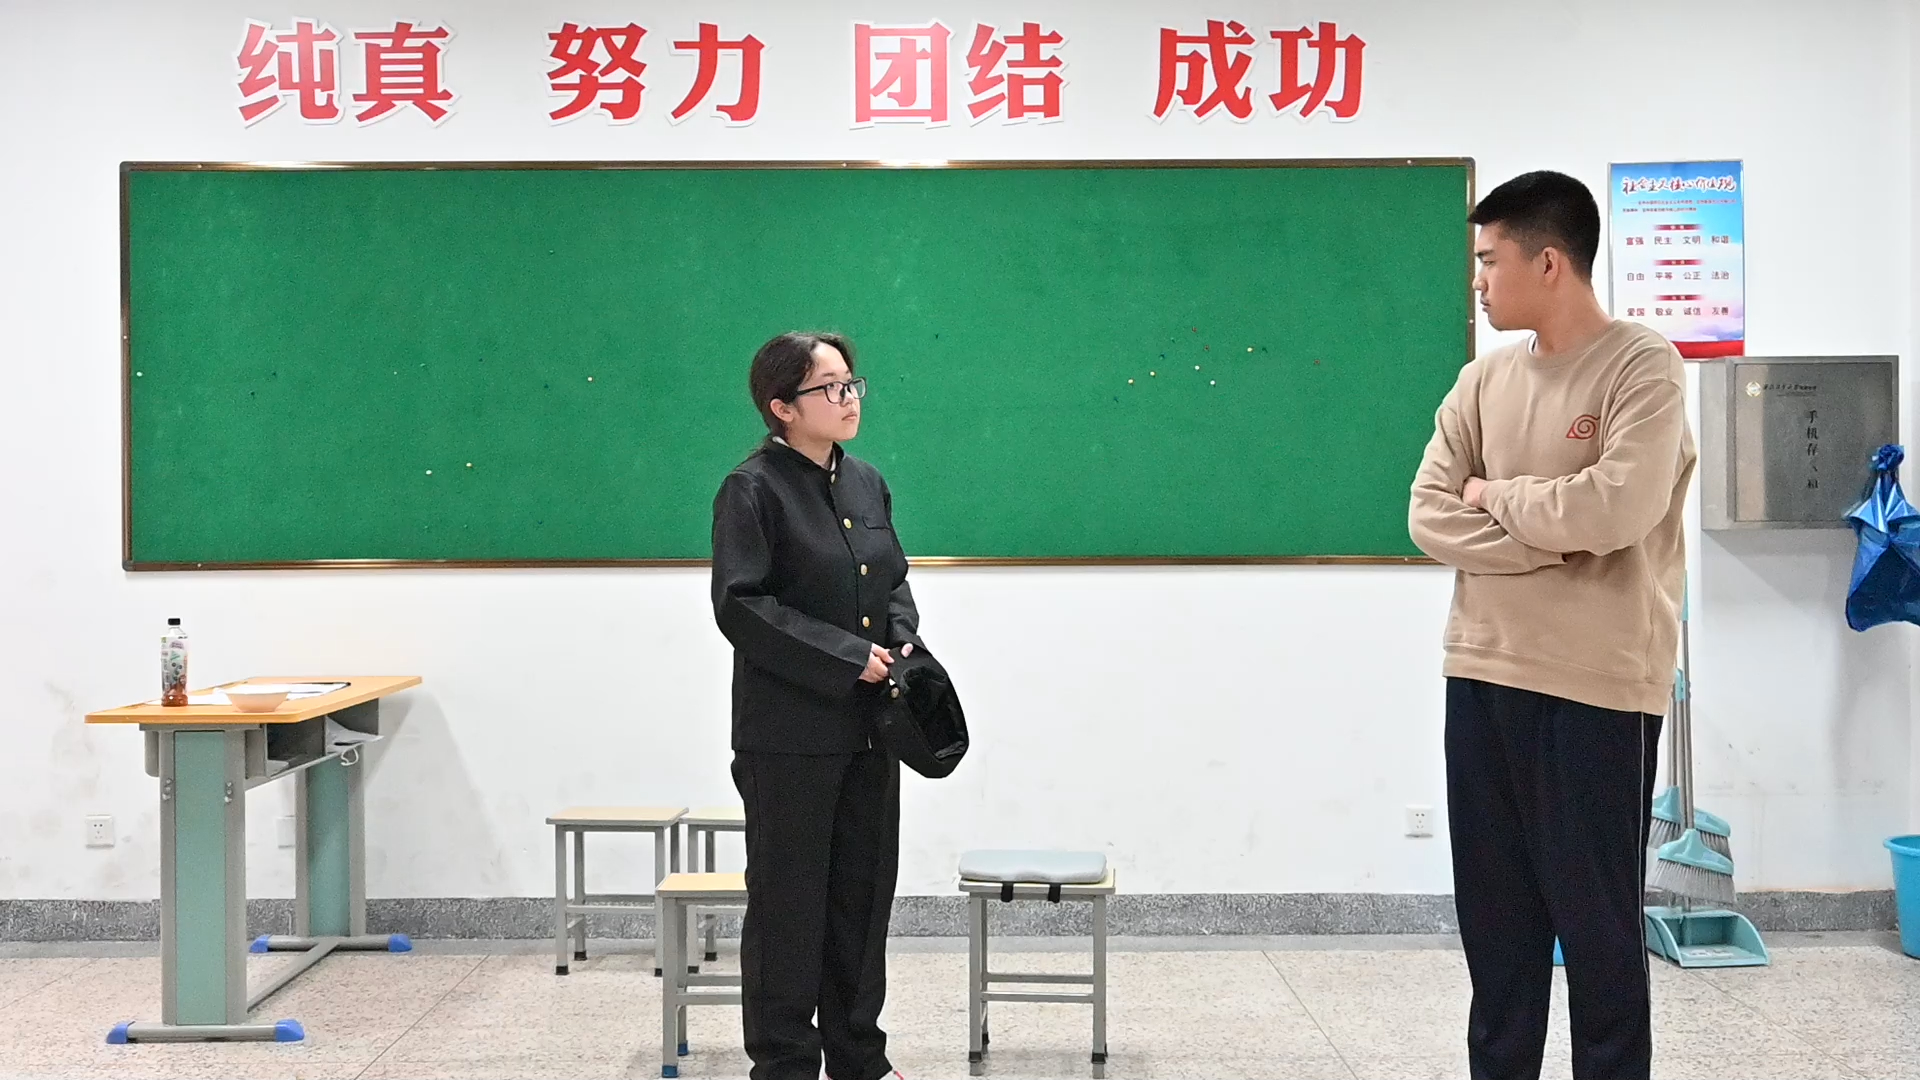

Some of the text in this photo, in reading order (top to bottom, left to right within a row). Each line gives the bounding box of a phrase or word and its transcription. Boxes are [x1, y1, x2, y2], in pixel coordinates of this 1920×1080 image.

[239, 18, 1368, 123] 纯真 努力 团结 成功
[1626, 235, 1730, 246] 富强 民主 文明 和谐
[1627, 271, 1730, 281] 自由 平等 公正 法治
[1627, 306, 1729, 317] 爱国 敬业 诚信 友善
